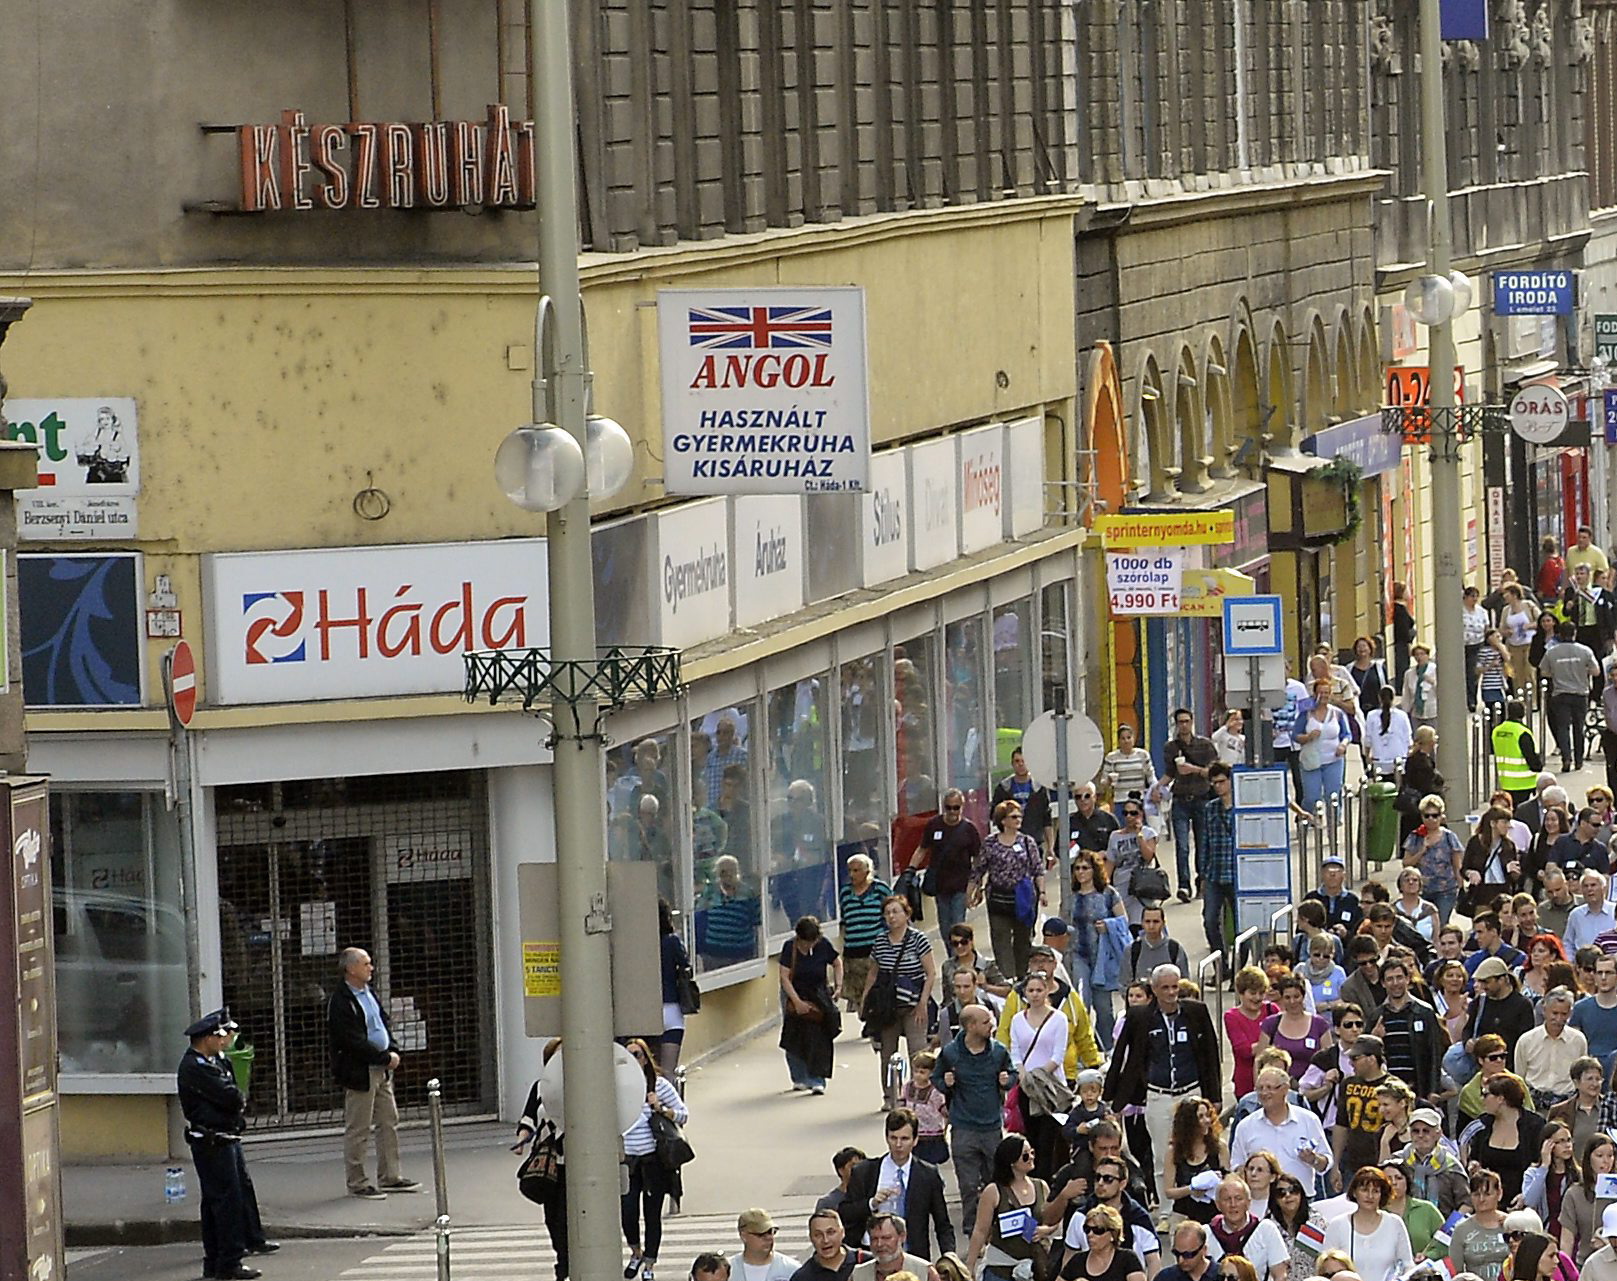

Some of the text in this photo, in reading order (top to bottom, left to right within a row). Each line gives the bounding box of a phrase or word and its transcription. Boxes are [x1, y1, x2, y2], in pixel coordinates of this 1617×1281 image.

[1499, 272, 1567, 289] FORDÍTÓ
[1509, 291, 1558, 304] IRODA
[689, 353, 836, 389] ANGOL
[1514, 396, 1563, 414] ÓRÁS
[700, 405, 827, 429] HASZNÁLT
[673, 434, 855, 453] GYERMEKRUHA
[692, 455, 834, 478] KISÁRUHÁZ
[24, 510, 129, 526] Berzsenyi Dániel utca
[1105, 520, 1207, 541] sprinternyomda.hu
[664, 520, 787, 614] Gyermekruha Áruház
[1112, 557, 1173, 570] 1000 db
[1117, 571, 1169, 585] szórólap
[1110, 593, 1179, 609] 4.990 Ft
[314, 581, 528, 661] Háda
